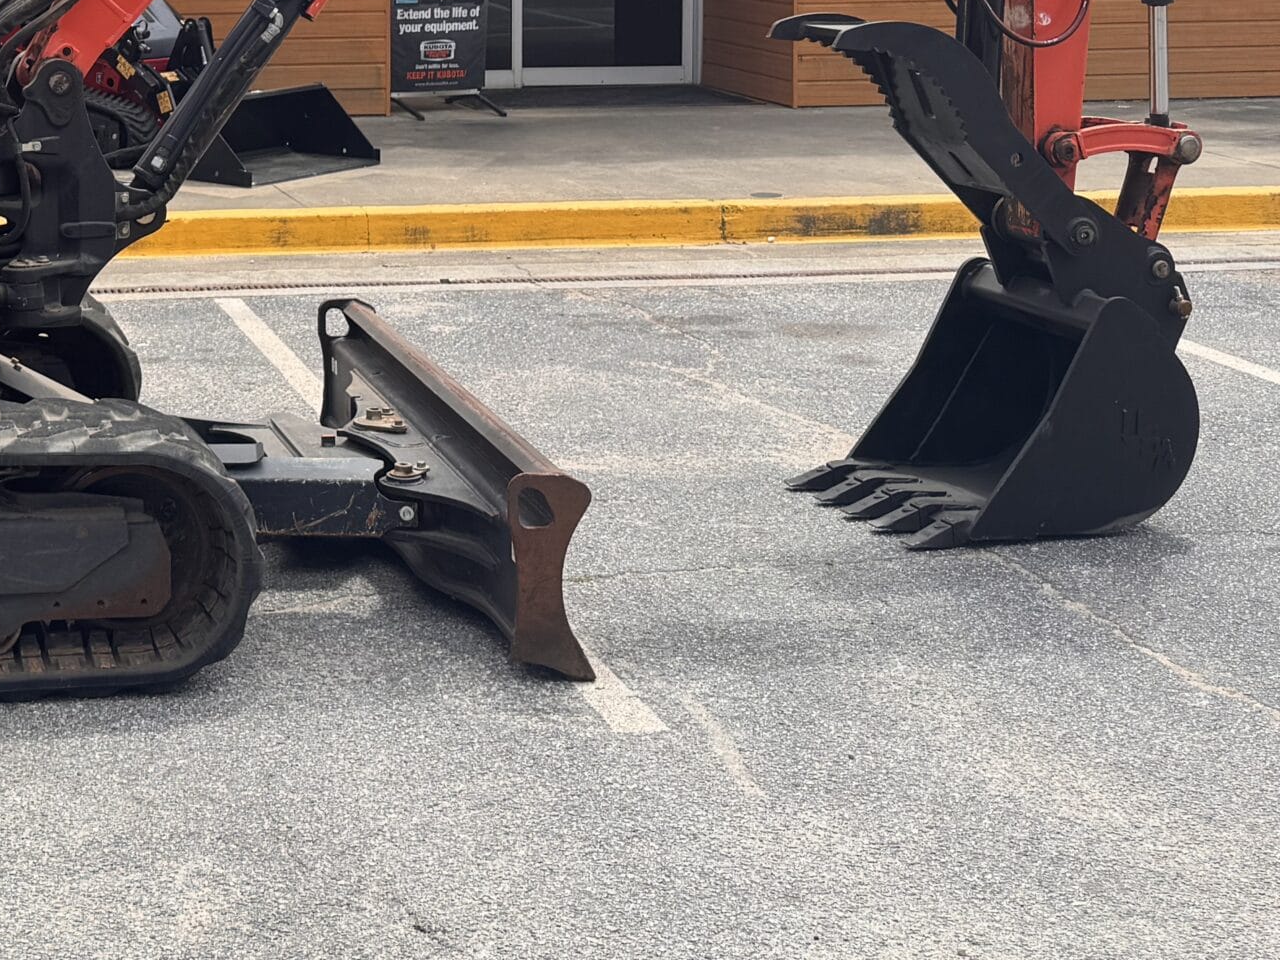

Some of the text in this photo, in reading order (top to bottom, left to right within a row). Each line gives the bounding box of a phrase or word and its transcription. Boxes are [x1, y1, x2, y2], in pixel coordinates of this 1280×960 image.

[396, 5, 480, 20] Extend the life of
[399, 20, 479, 35] your equipment.
[406, 71, 426, 80] KEEP
[427, 71, 435, 79] IT
